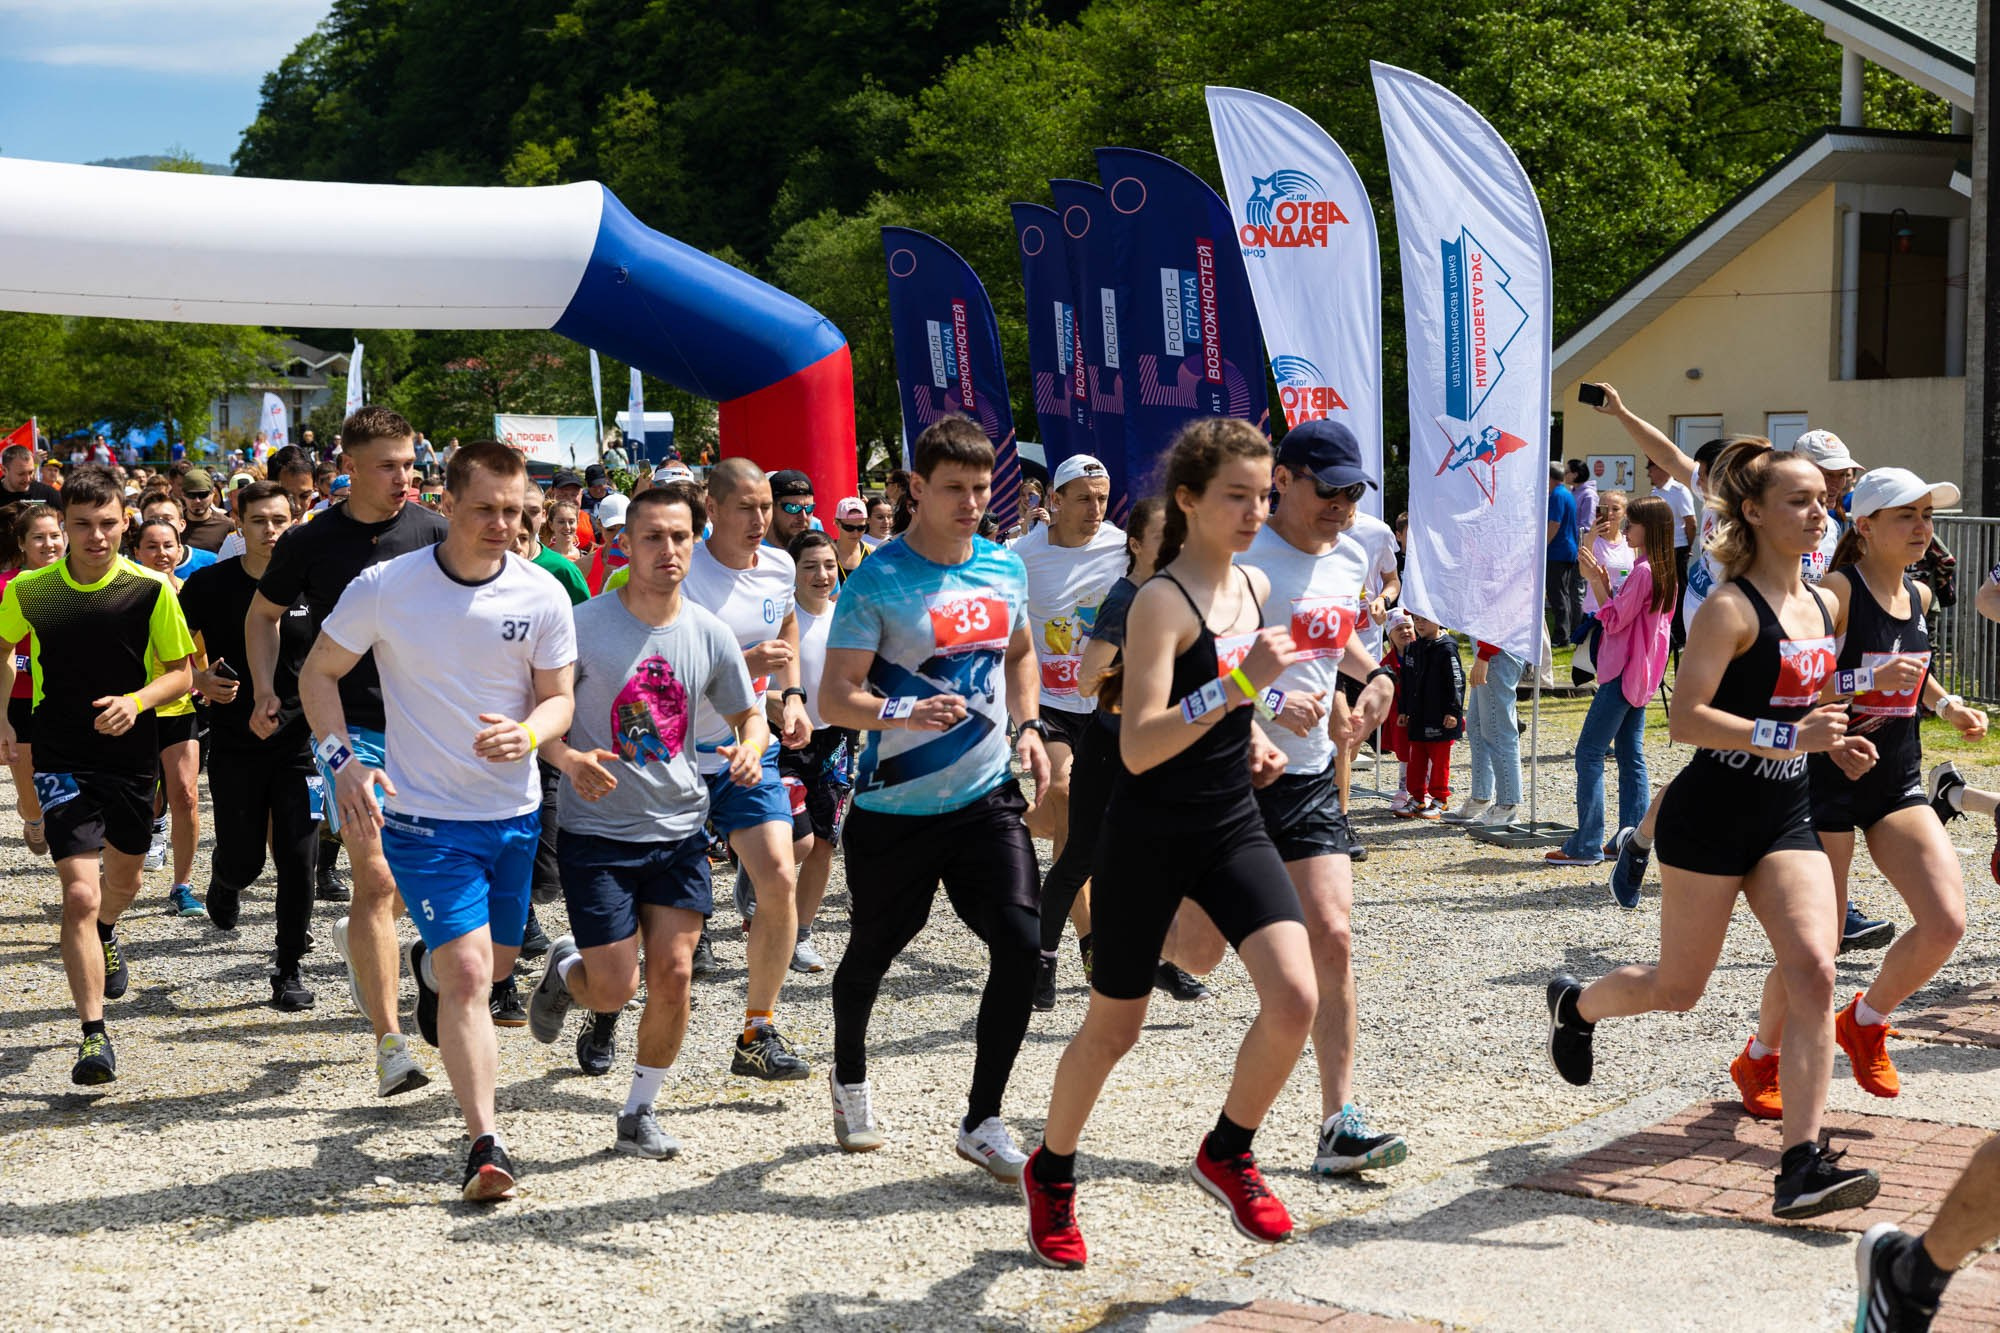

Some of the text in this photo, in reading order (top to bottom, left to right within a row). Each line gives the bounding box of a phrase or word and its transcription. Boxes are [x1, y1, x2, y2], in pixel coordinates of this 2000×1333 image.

[1165, 287, 1181, 352] РОССИЯ
[1184, 277, 1200, 340] СТРАНА
[1197, 245, 1221, 380] ВОЗМОЖНОСТЕЙ
[1064, 309, 1073, 362] СТРАНА
[1104, 305, 1117, 364] РОССИЯ
[943, 327, 957, 377] СТРАНА
[952, 303, 974, 408] ВОЗМОЖНОСТЕЙ
[1212, 392, 1221, 413] ЛЕТ
[502, 620, 530, 642] 37
[955, 600, 991, 634] 33
[1307, 610, 1341, 639] 69
[1800, 653, 1826, 686] 94
[1842, 673, 1854, 690] 83
[1266, 692, 1280, 709] 69
[1776, 726, 1790, 745] 94
[334, 752, 345, 764] 2
[1753, 754, 1803, 780] NIKE
[421, 898, 435, 921] 5
